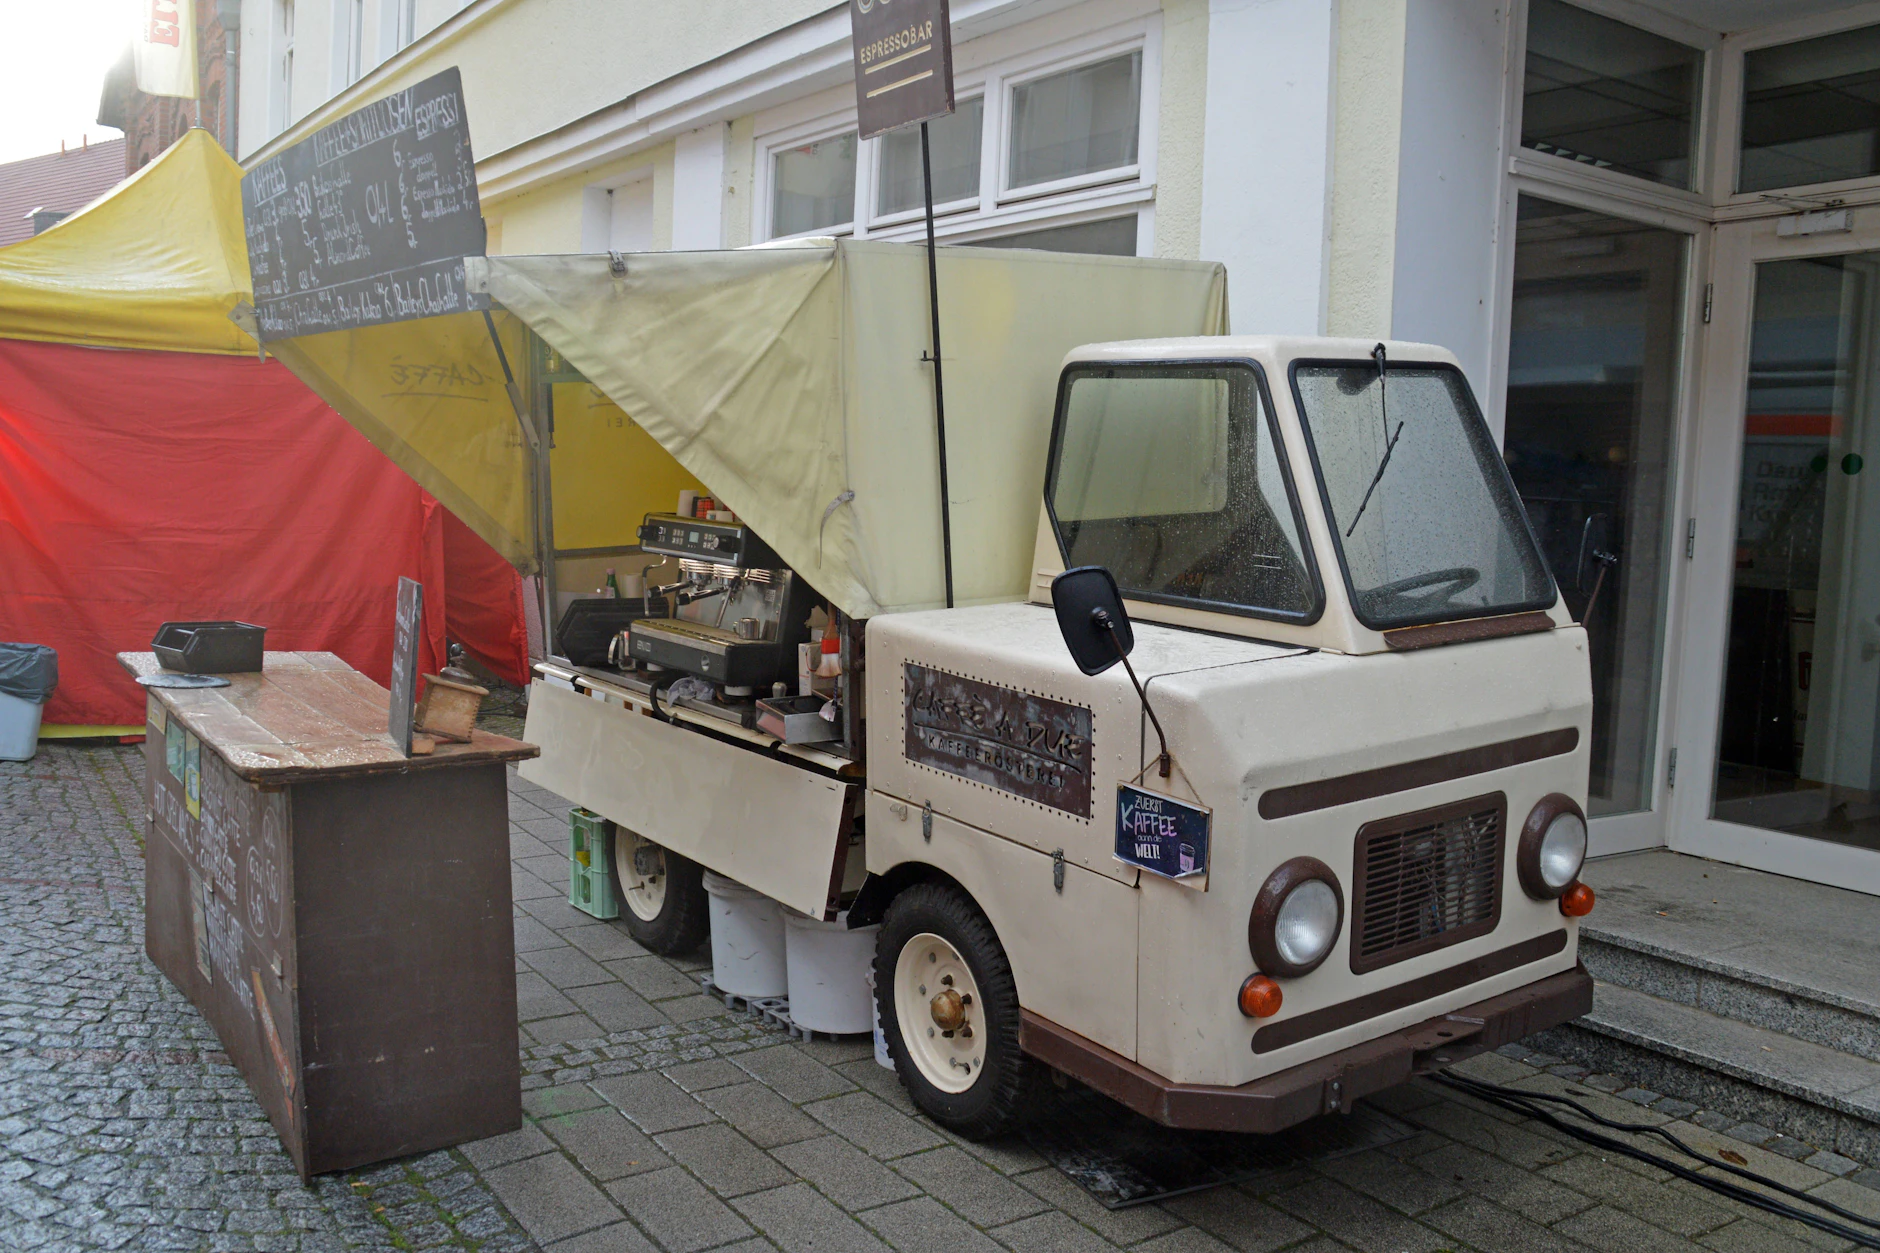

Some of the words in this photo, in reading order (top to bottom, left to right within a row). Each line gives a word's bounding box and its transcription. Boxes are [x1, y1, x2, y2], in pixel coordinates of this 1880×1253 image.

[860, 20, 933, 64] ESPRESSOBAR
[995, 710, 1012, 741] A
[1025, 721, 1086, 760] DUE
[1121, 802, 1178, 837] KAFFEE
[1134, 794, 1163, 813] ZUERST
[1134, 843, 1161, 859] WELT!
